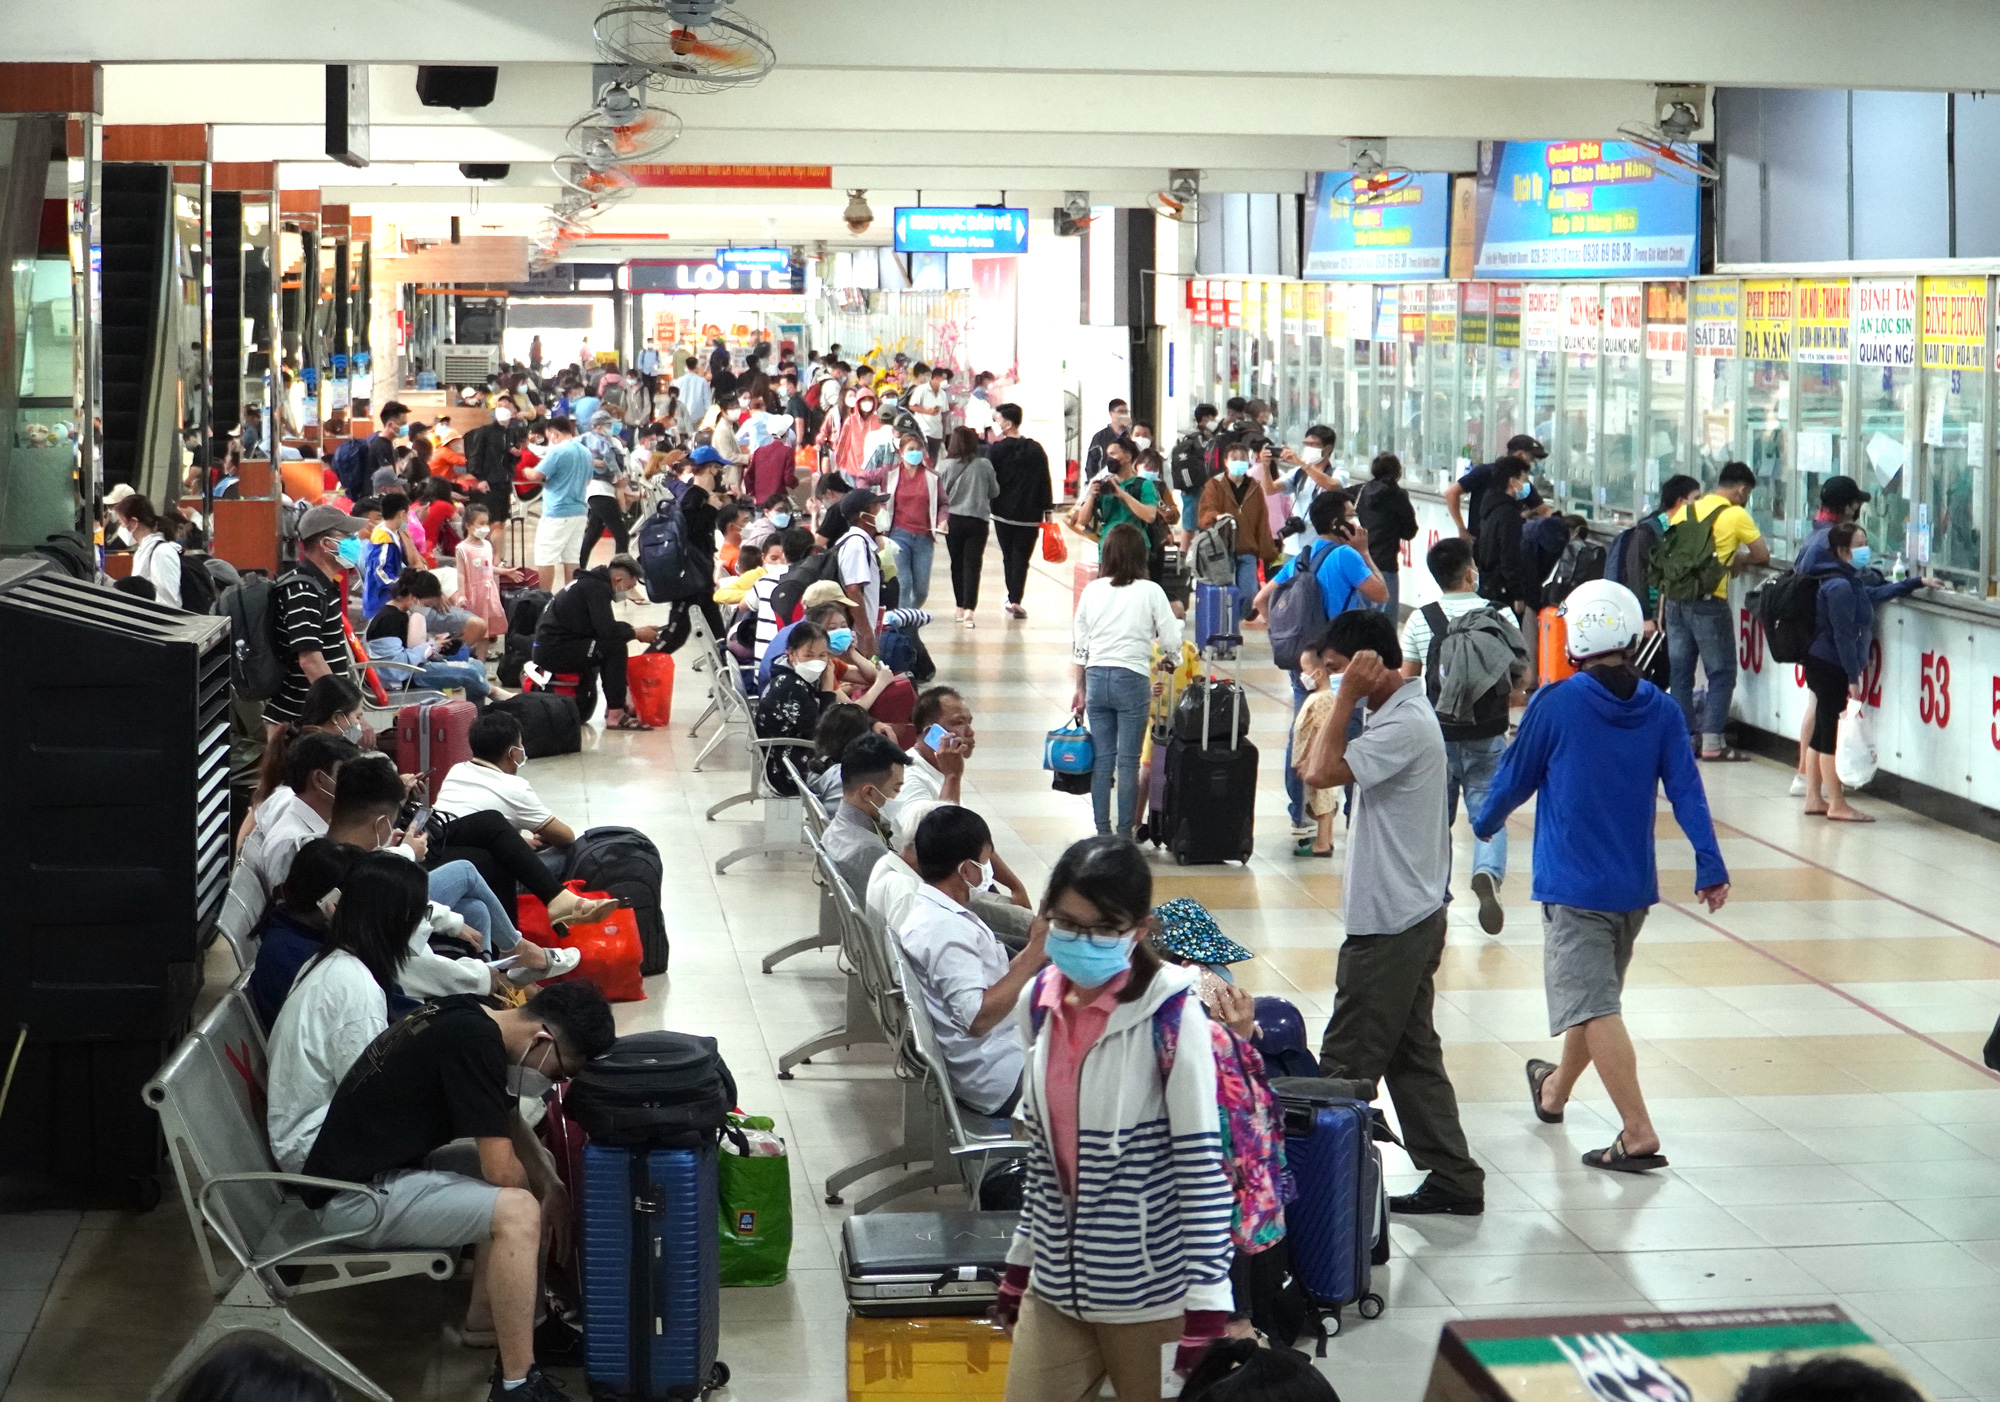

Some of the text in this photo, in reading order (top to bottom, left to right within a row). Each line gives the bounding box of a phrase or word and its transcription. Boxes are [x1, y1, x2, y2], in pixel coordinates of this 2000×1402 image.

[1746, 291, 1765, 318] PHI
[1860, 281, 1890, 311] BÌNH
[1925, 284, 1948, 335] BÌNH
[1695, 323, 1715, 345] SÁU
[1860, 318, 1873, 334] AN
[1896, 318, 1914, 334] SIN
[1925, 344, 1939, 364] NAM
[1941, 344, 1954, 364] TUY
[1740, 609, 1764, 674] 50
[1919, 650, 1950, 729] 53
